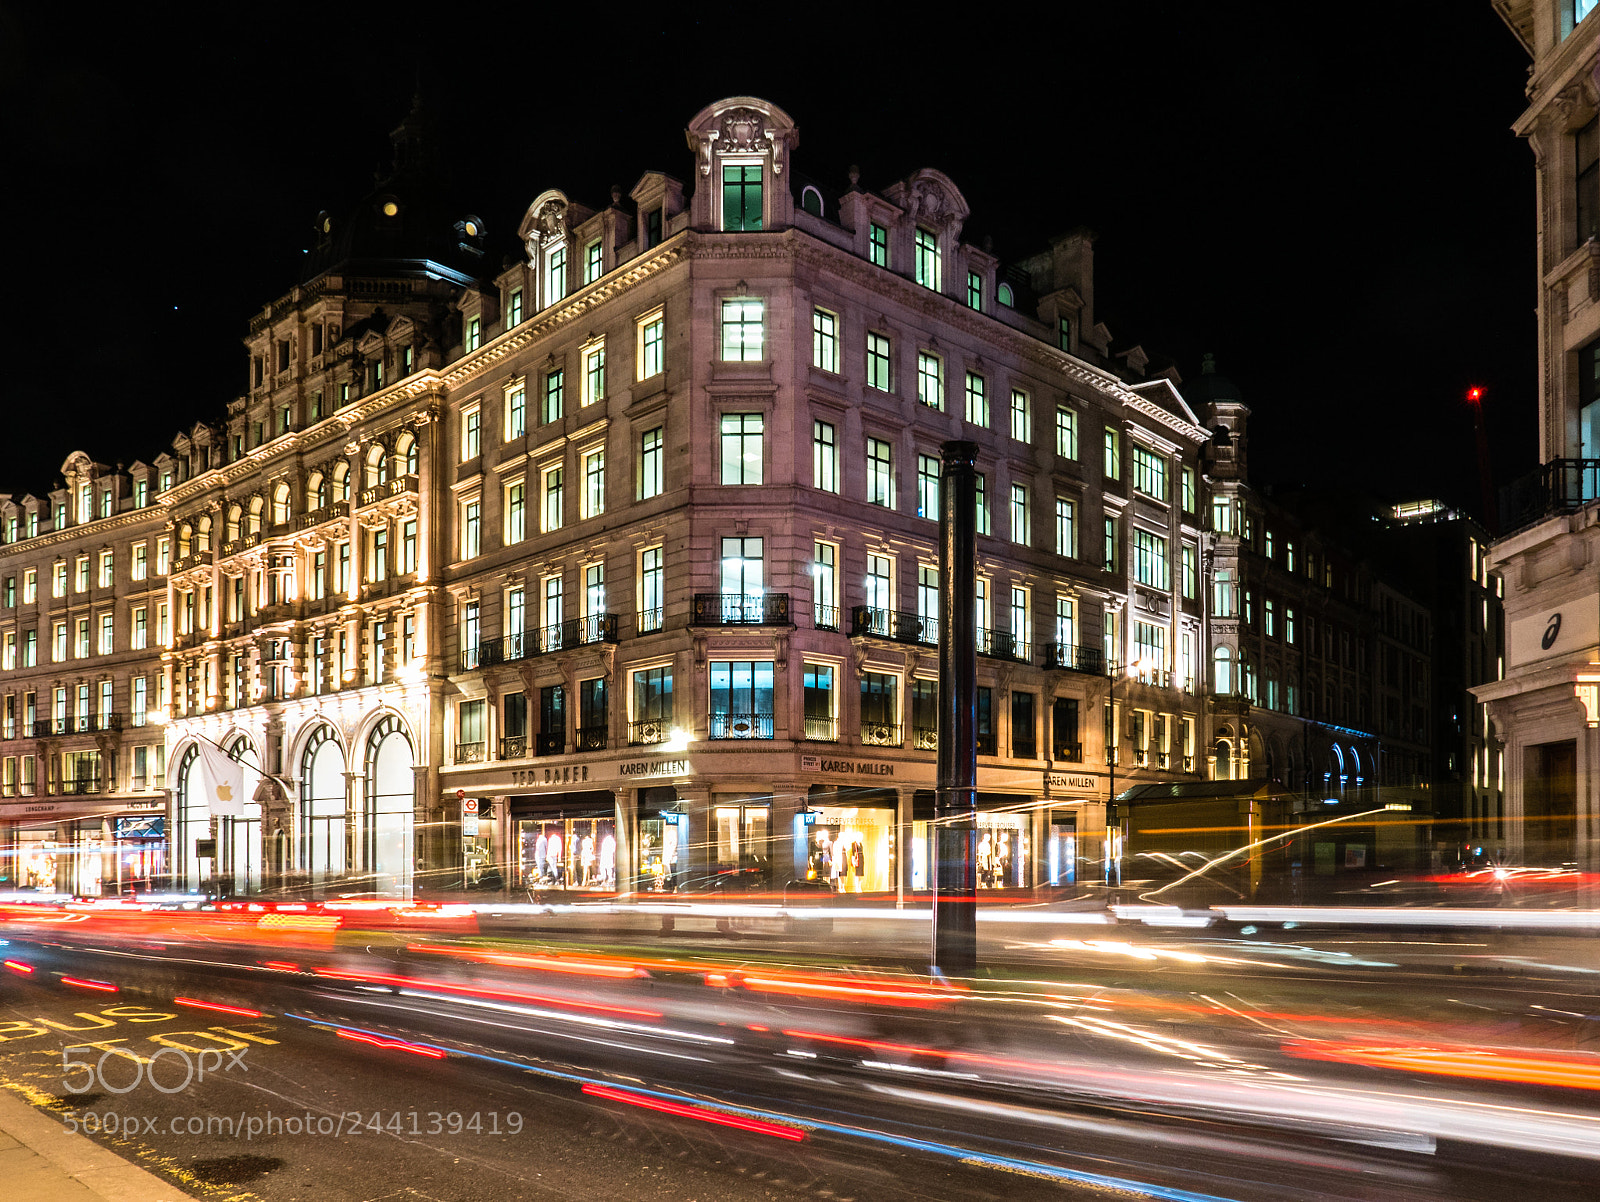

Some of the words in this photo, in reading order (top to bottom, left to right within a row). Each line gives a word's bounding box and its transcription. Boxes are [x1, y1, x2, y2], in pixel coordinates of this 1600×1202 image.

[620, 762, 648, 776] KAREN
[650, 760, 685, 775] MILLEN
[821, 760, 854, 773] KAREN
[857, 763, 894, 775] MILLEN
[512, 771, 535, 787] TED
[545, 766, 588, 784] BAKER
[1068, 777, 1095, 788] MILLEN
